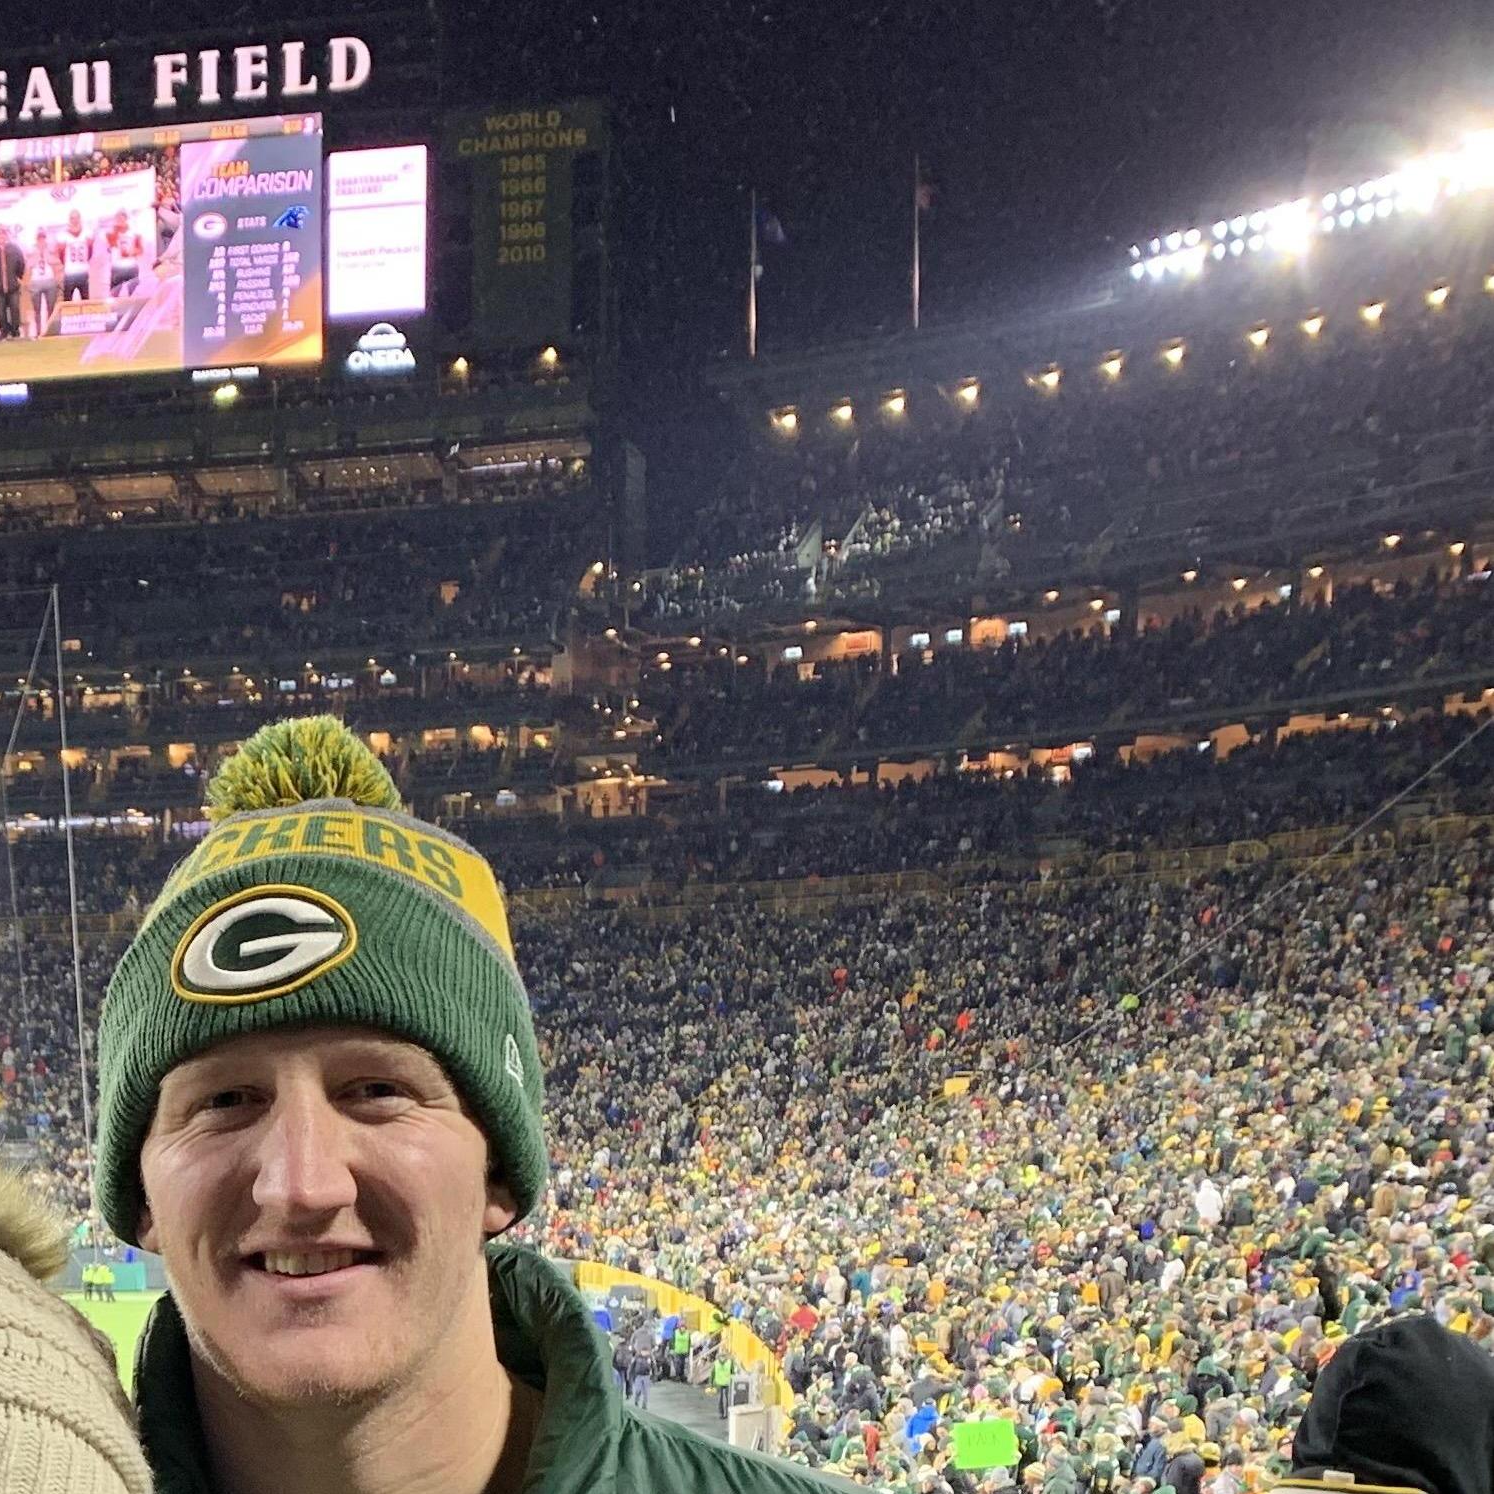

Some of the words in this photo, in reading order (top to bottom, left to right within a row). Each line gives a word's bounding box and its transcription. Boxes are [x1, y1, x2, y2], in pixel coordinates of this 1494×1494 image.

[153, 36, 372, 107] FIELD
[485, 110, 561, 132] WORLD
[458, 128, 587, 155] CHAMPIONS
[193, 169, 313, 200] COMPARISON
[347, 347, 416, 371] ONEIDA
[182, 896, 344, 990] G
